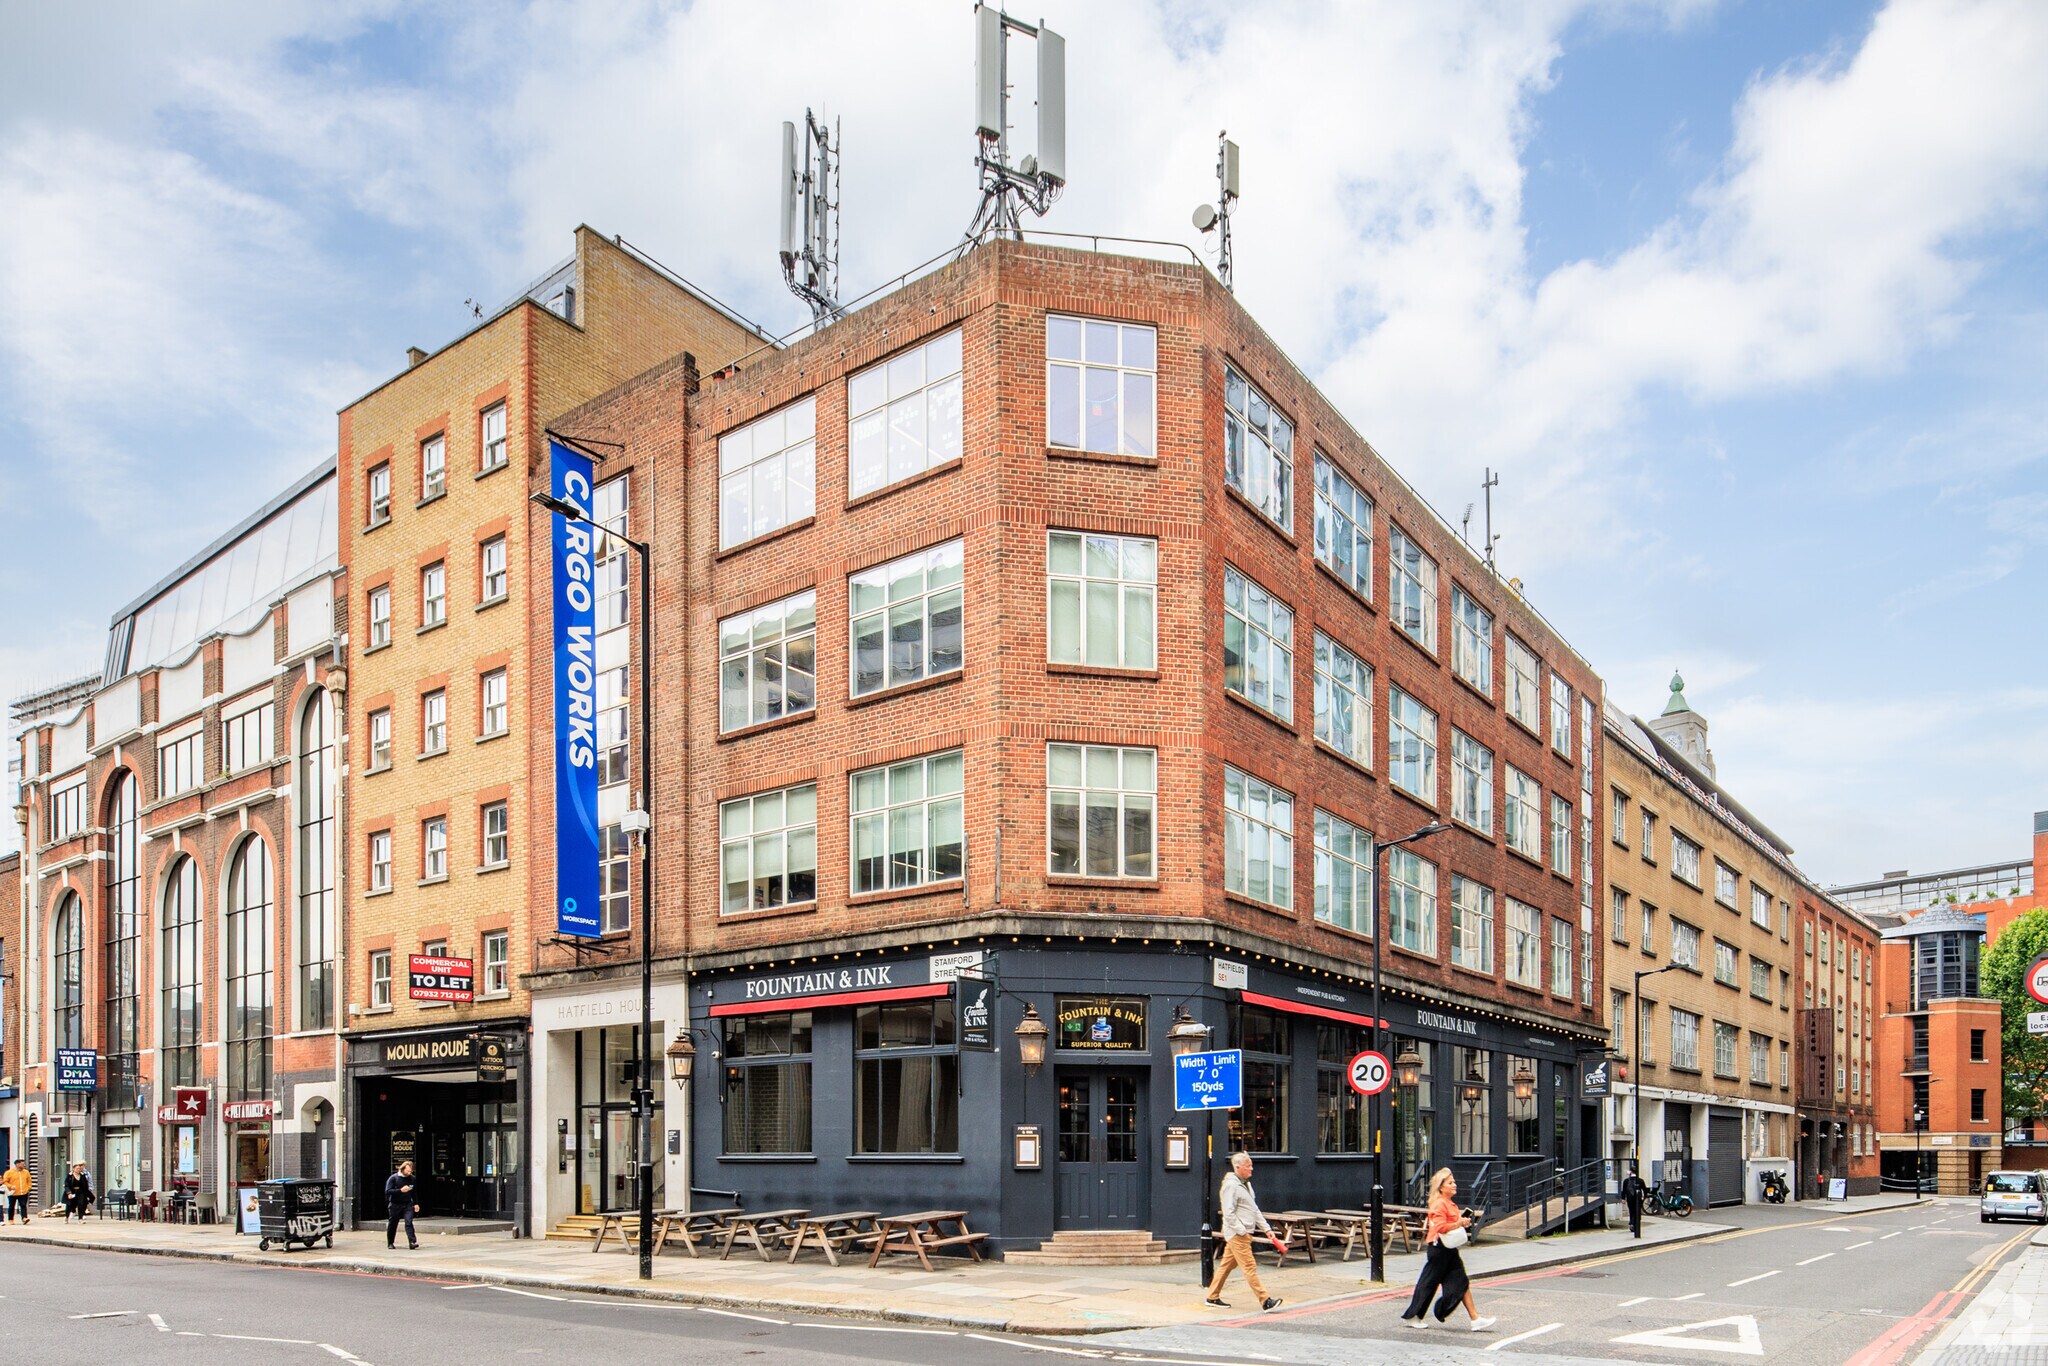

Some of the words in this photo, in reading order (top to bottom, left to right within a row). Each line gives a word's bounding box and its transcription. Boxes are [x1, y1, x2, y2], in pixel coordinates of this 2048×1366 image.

[565, 470, 591, 612] CARGO
[567, 626, 594, 769] WORKS
[562, 915, 597, 926] WORKSPACE
[413, 957, 469, 968] COMMERCIAL
[934, 956, 973, 967] STAMFORD
[1218, 961, 1245, 974] HATFIELDS
[934, 968, 960, 978] STREE
[1218, 972, 1227, 982] SE1
[413, 974, 436, 987] TO
[440, 976, 470, 989] LET
[746, 971, 835, 998] FOUNTAIN
[839, 970, 852, 989] &
[856, 965, 891, 987] INK
[413, 990, 438, 998] 07932
[558, 1002, 613, 1018] HATFIELD
[620, 997, 656, 1013] HOUE
[973, 1016, 988, 1026] INK
[1058, 1006, 1112, 1023] FOUNTAIN
[1114, 1008, 1122, 1018] &
[1124, 1010, 1144, 1026] INK
[1417, 1010, 1456, 1031] FOUNTAIN
[1456, 1018, 1463, 1032] &
[1463, 1020, 1477, 1035] INK
[386, 1043, 428, 1061] MOULIN
[431, 1040, 470, 1058] ROUDE
[60, 1056, 74, 1066] TO
[76, 1056, 94, 1067] LET
[1180, 1056, 1206, 1068] Width
[1213, 1054, 1236, 1065] Limit
[63, 1069, 91, 1078] DMA
[1355, 1064, 1385, 1082] 20
[1192, 1081, 1224, 1093] 150yds
[1664, 1130, 1683, 1152] RGO
[1664, 1160, 1683, 1182] RKS
